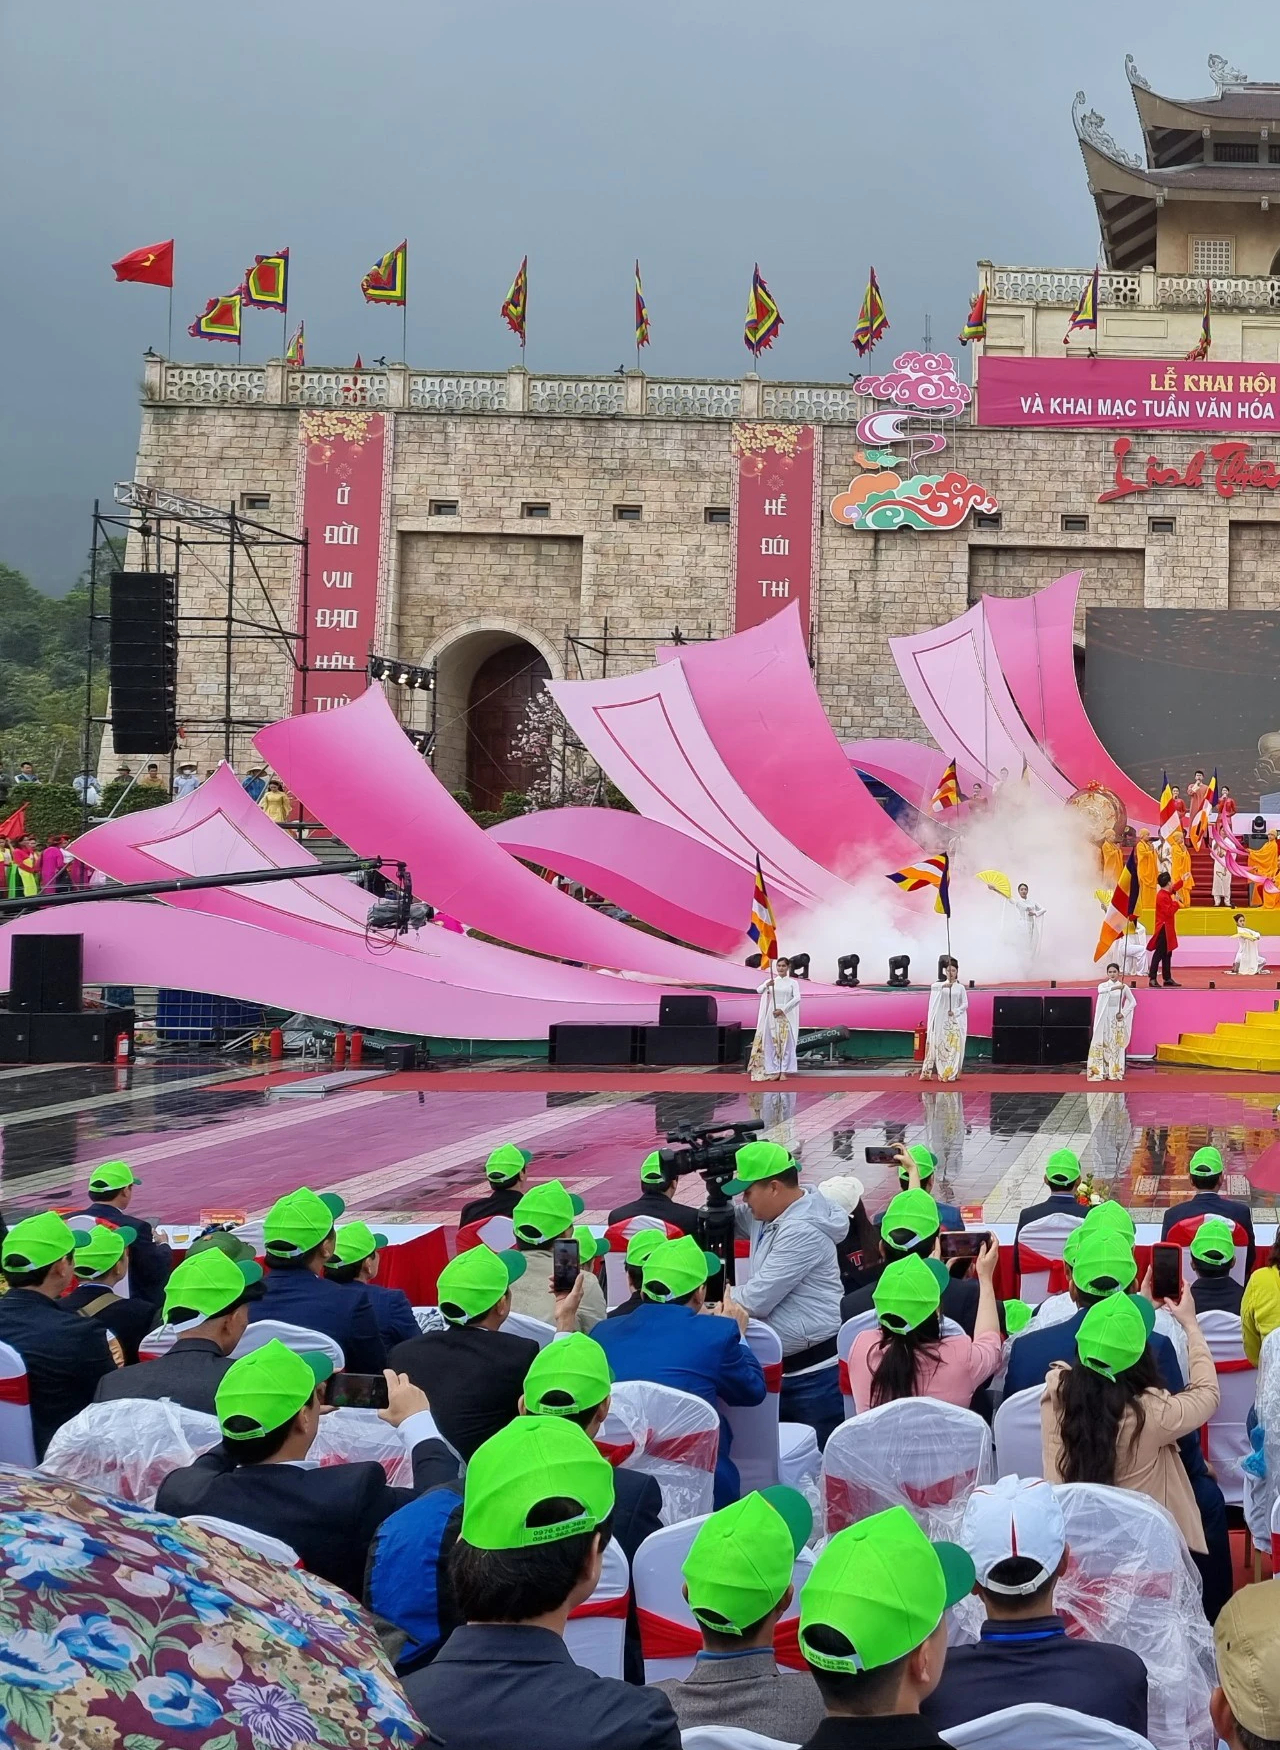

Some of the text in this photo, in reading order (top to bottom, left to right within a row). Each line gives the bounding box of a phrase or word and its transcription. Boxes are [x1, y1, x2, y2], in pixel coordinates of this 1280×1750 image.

[1151, 367, 1177, 391] LỄ
[1184, 375, 1233, 392] KHAI
[1240, 372, 1276, 397] HỘI
[1021, 393, 1044, 413] VÀ
[1050, 398, 1091, 415] KHAI
[1098, 399, 1136, 419] MẠC
[1143, 394, 1189, 417] TUẦN
[1196, 397, 1231, 418] VĂN
[1238, 398, 1274, 419] HÓA
[1097, 437, 1206, 503] Linh
[337, 483, 350, 504] Ở
[323, 521, 359, 544] ĐỜI
[758, 493, 789, 597] HỄ ĐÓI THÌ
[323, 571, 352, 588] VUI
[315, 609, 358, 631] ĐẠO
